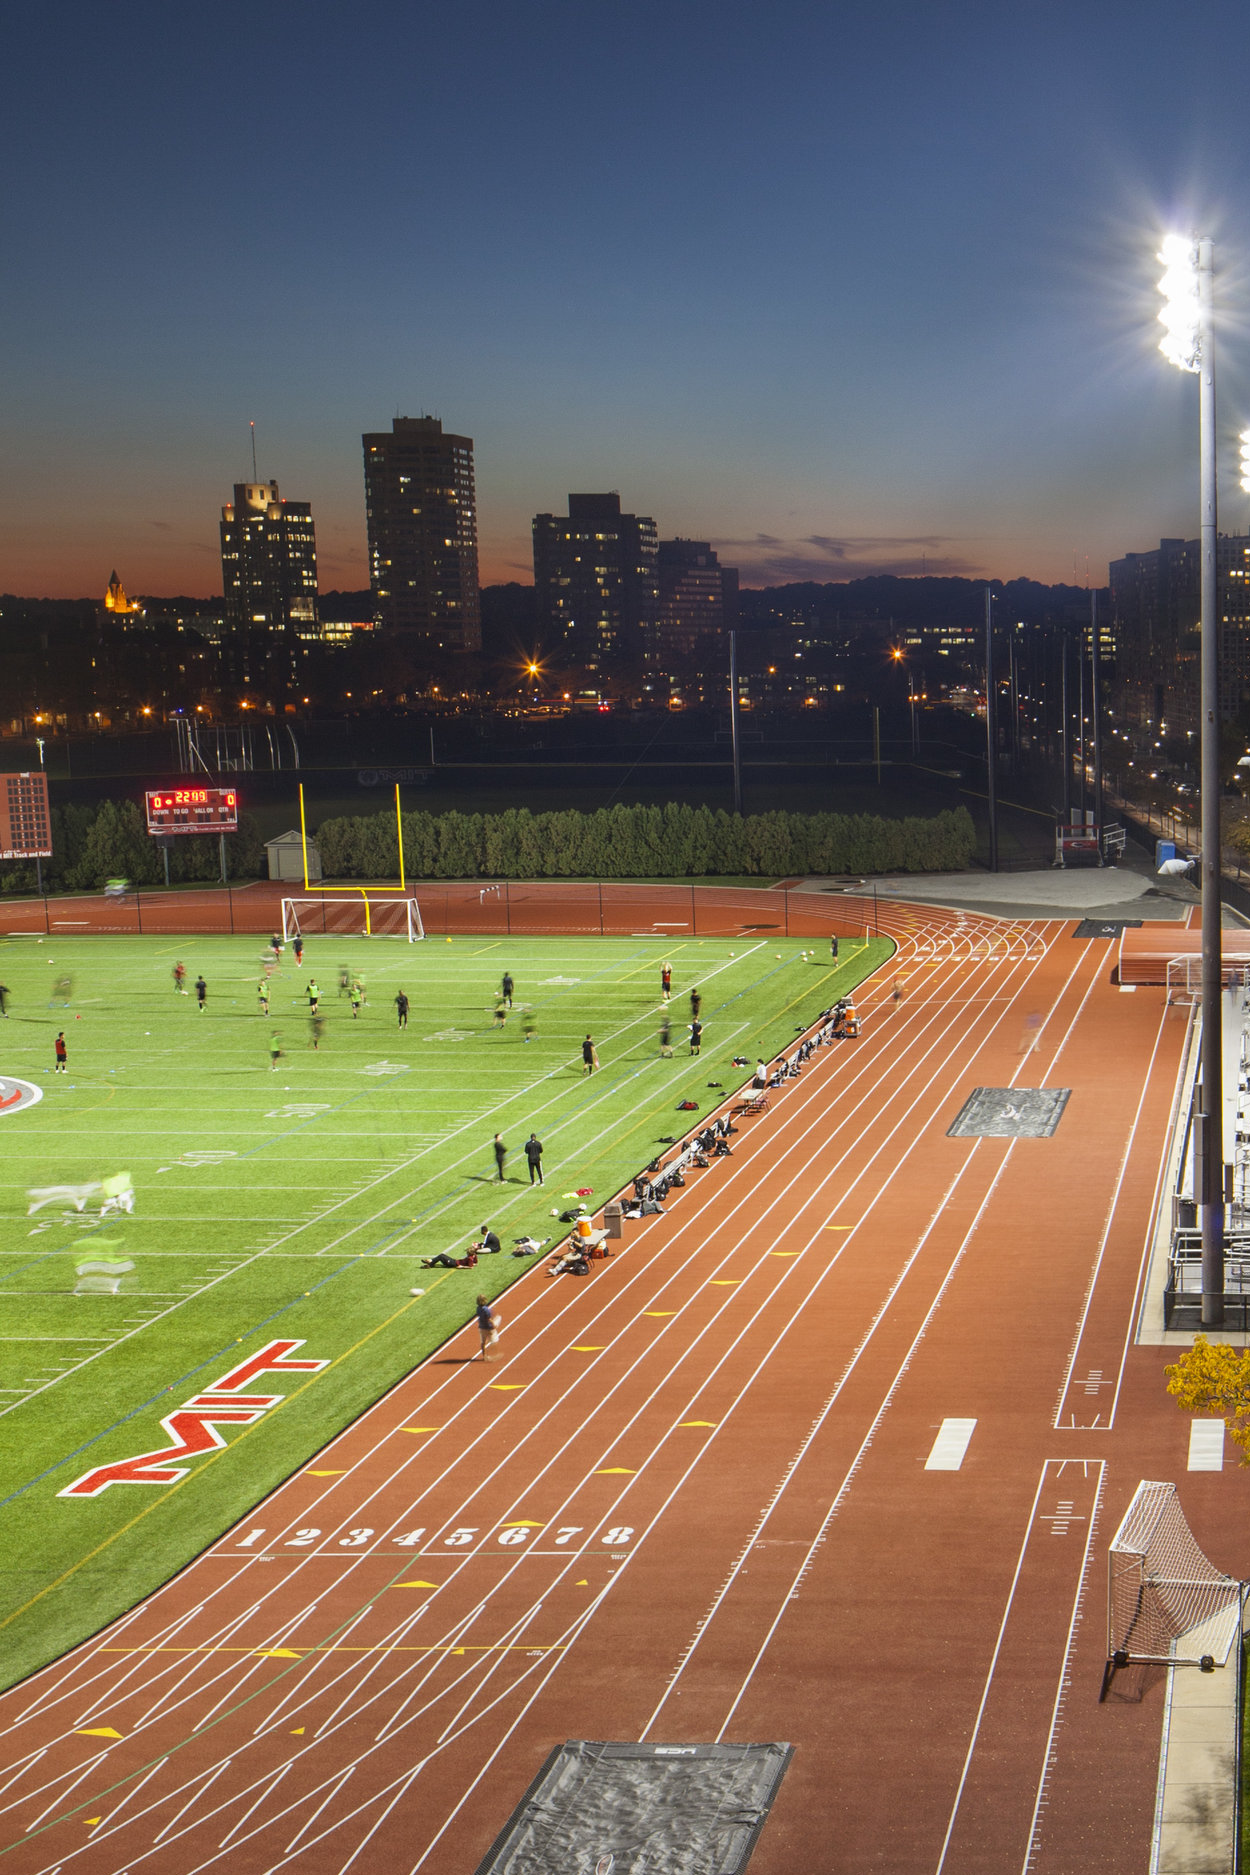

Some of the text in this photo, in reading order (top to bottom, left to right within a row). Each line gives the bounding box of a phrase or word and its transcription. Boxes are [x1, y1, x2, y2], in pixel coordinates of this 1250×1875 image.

[264, 1103, 331, 1118] 50
[55, 1339, 331, 1497] MIT
[235, 1526, 634, 1547] 1 2 3 4 5 6 7 8
